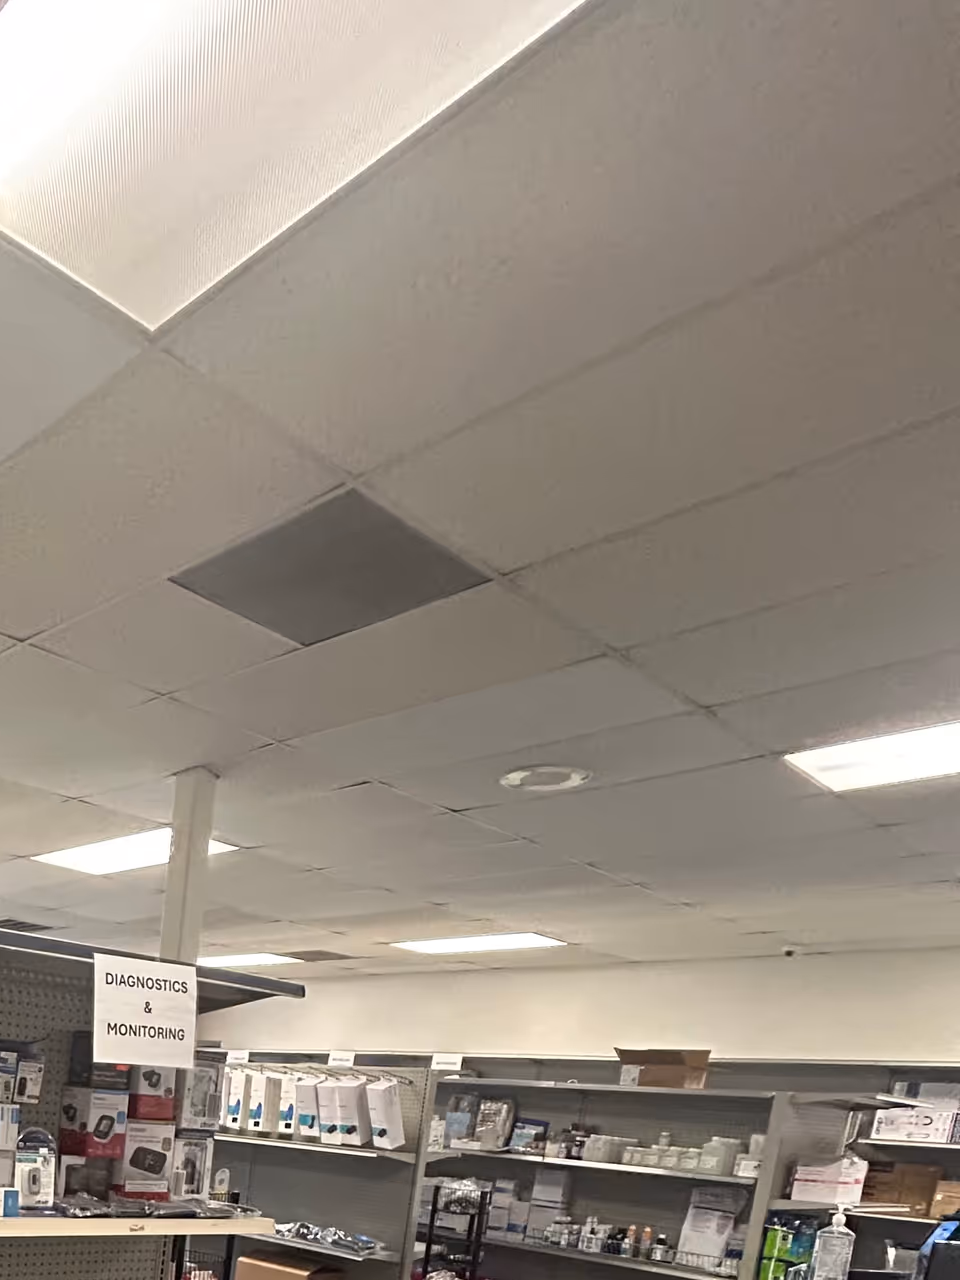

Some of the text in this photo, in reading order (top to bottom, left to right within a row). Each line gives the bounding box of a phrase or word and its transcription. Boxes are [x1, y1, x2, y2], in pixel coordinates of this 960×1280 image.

[105, 972, 188, 994] DIAGNOSTICS
[144, 1001, 153, 1014] &
[107, 1022, 186, 1041] MONITORING
